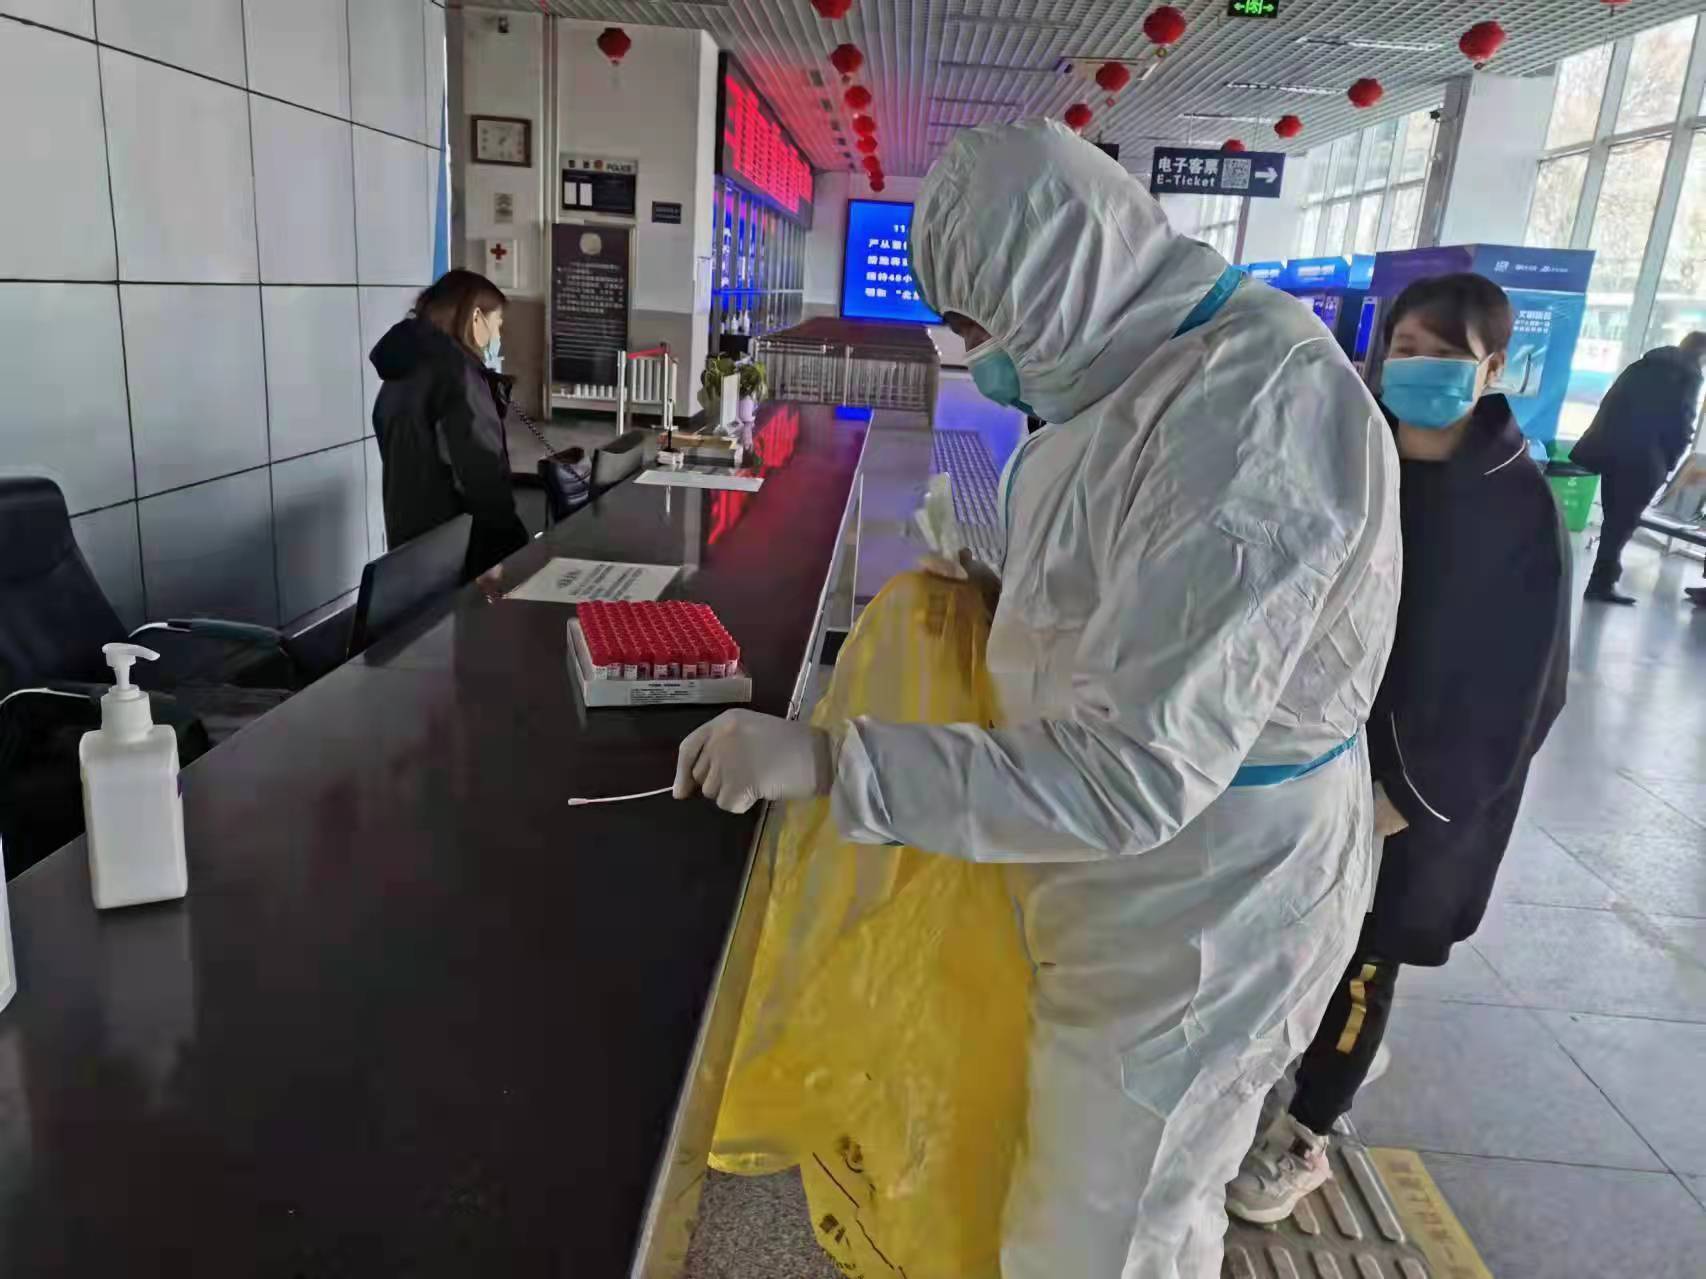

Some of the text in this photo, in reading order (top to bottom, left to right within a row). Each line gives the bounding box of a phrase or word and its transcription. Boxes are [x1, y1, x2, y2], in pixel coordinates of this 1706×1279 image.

[1158, 156, 1219, 175] 电子客票
[1156, 174, 1215, 187] E-Ticket
